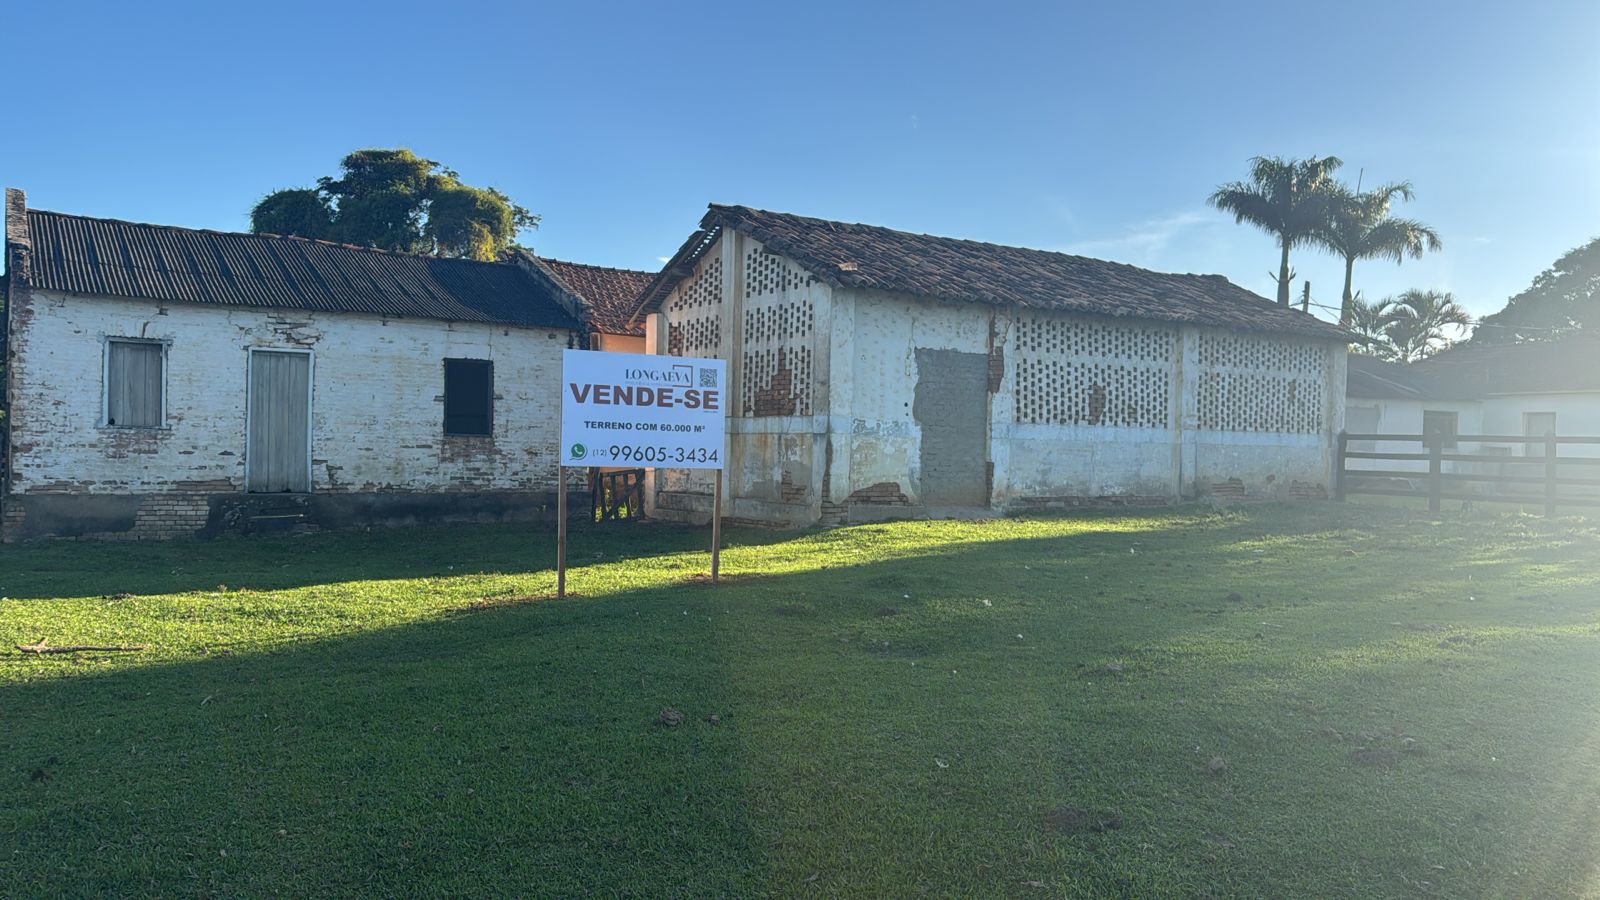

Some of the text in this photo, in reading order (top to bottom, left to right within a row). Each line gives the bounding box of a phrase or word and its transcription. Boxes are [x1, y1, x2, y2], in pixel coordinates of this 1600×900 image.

[625, 369, 690, 383] LONGAEVA
[570, 383, 719, 410] VENDE-SE
[584, 421, 633, 430] TERRENO
[635, 422, 658, 431] COM
[660, 424, 691, 432] 60.000
[609, 445, 719, 463] 99605-3434
